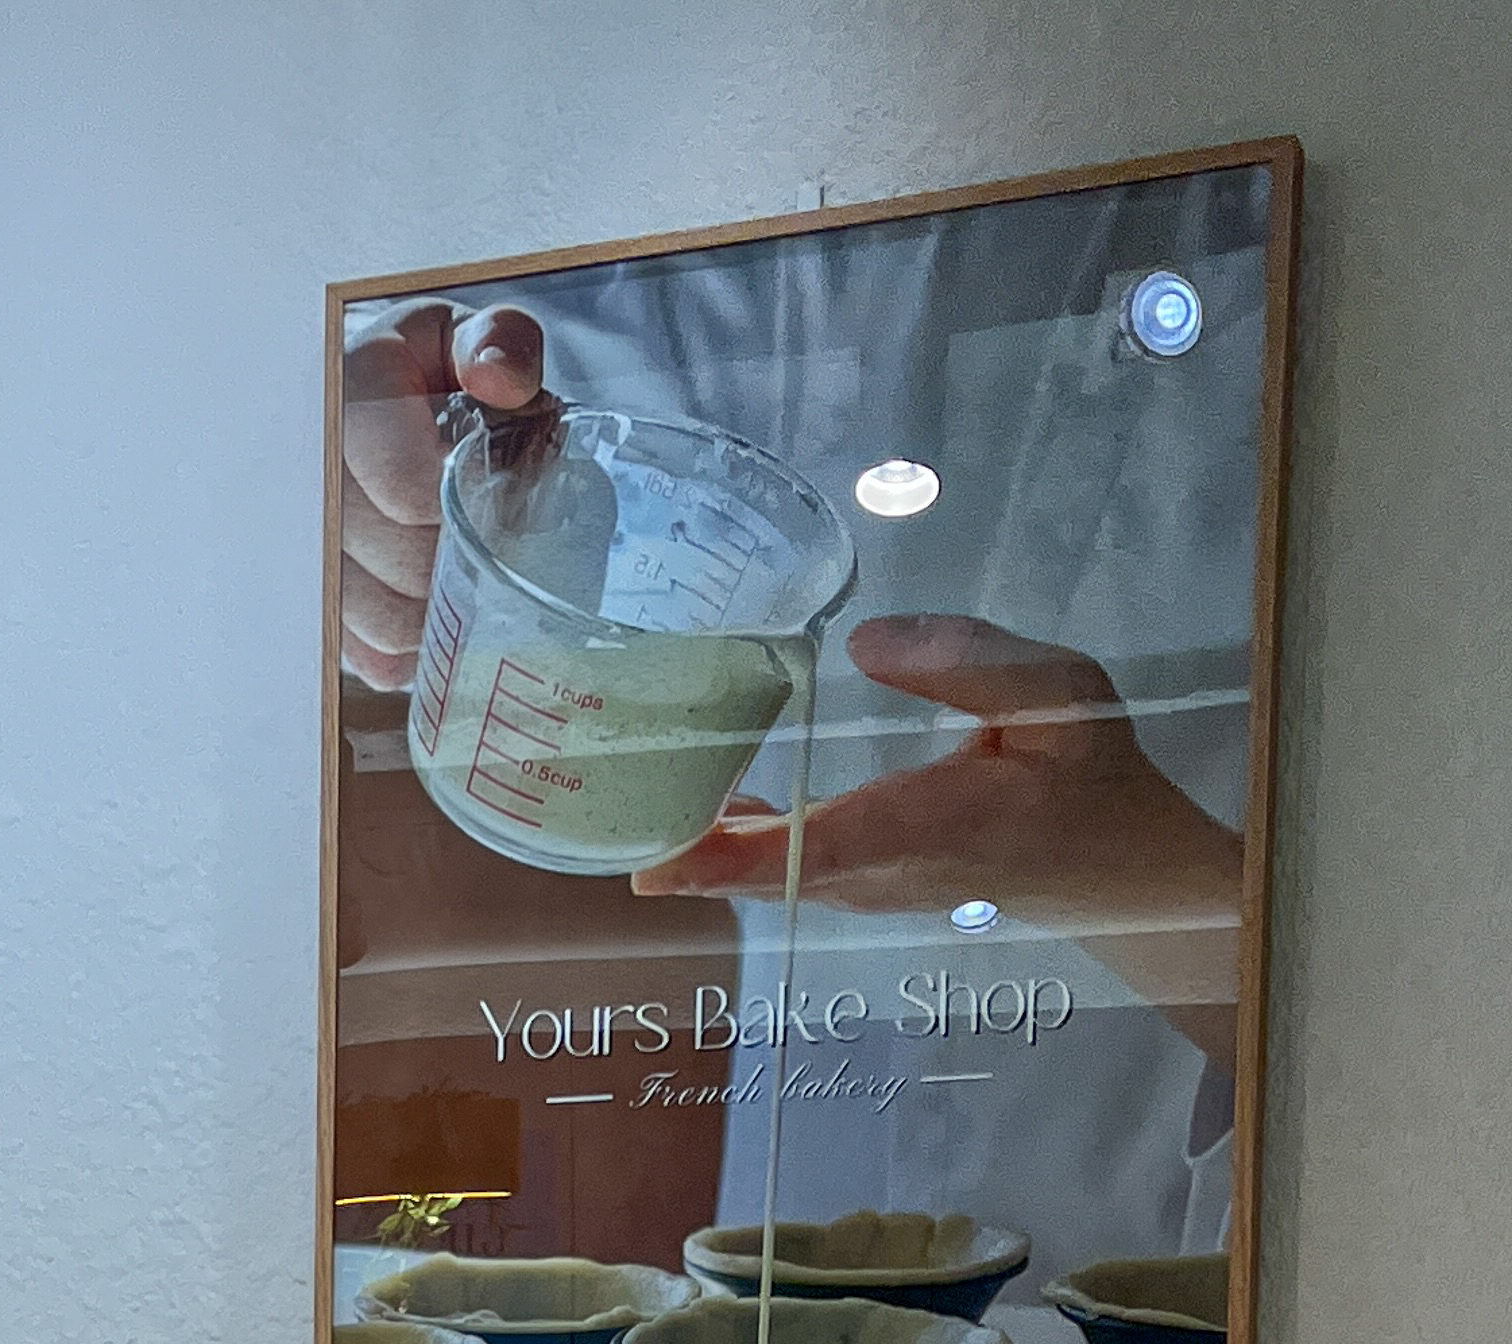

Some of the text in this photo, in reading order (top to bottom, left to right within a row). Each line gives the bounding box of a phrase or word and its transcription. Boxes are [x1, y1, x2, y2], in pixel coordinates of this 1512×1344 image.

[479, 970, 1074, 1063] Yours Bake Shop
[628, 1059, 909, 1114] French bakery
